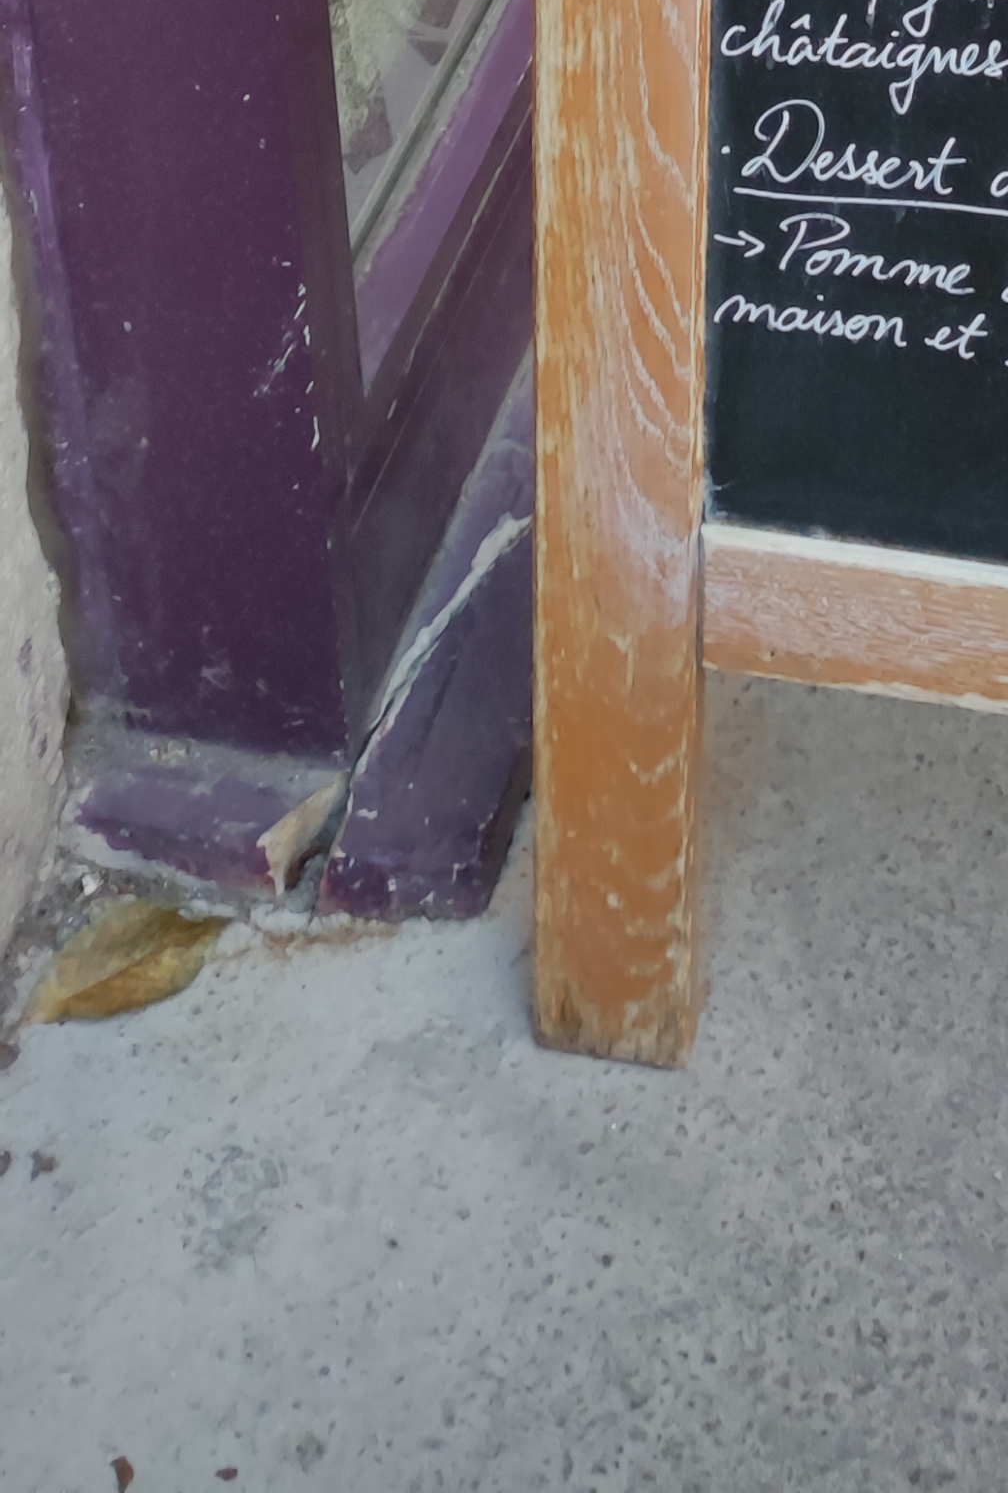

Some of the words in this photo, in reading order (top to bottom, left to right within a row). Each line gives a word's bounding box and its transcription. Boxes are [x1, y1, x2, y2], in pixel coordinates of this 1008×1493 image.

[778, 213, 975, 296] Pomme
[713, 294, 907, 349] maison
[924, 313, 988, 361] et
